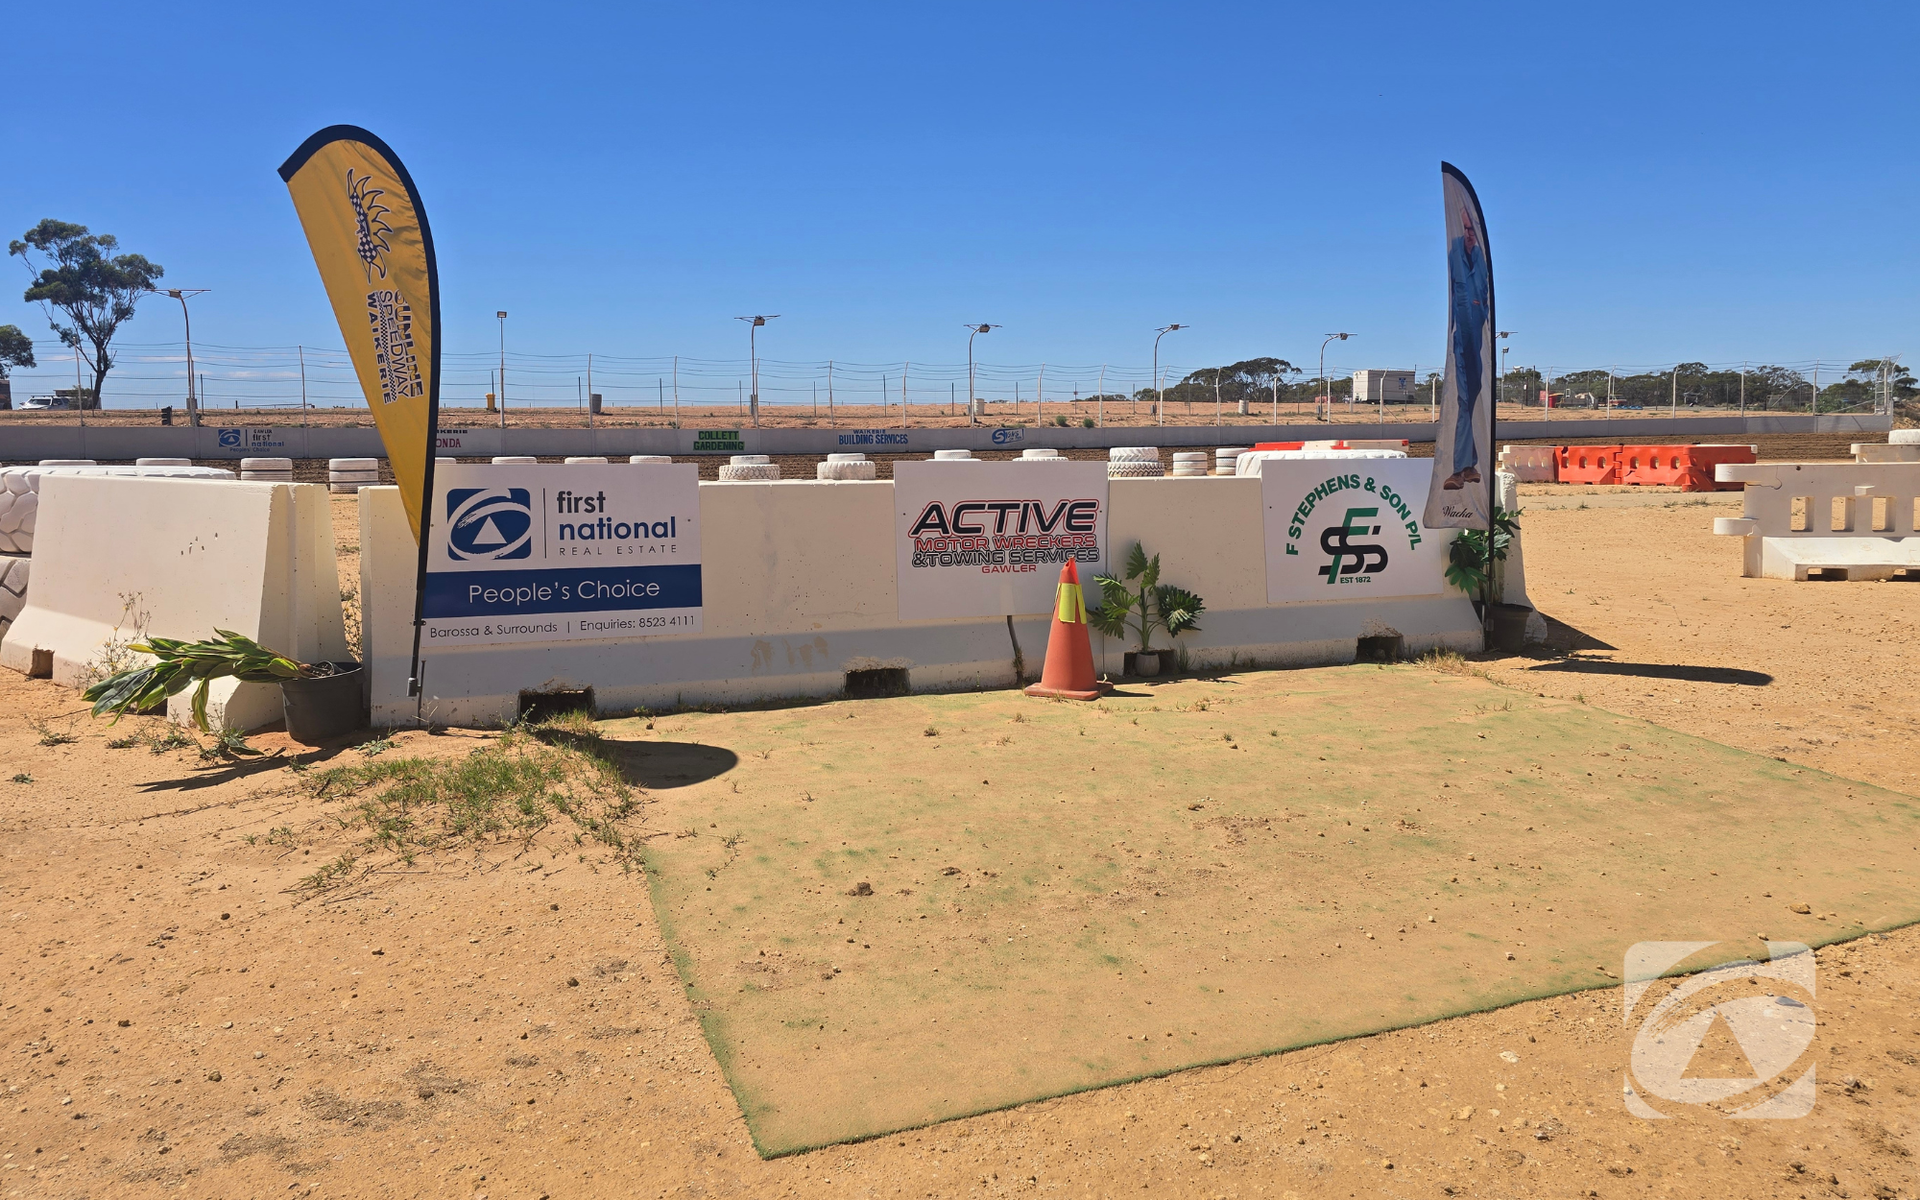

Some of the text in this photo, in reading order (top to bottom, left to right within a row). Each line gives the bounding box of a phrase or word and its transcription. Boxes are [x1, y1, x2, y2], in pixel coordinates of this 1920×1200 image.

[367, 292, 392, 404] WAIKERIE
[380, 290, 410, 397] SPEEDWAY
[394, 289, 424, 398] SUNLINE
[436, 438, 462, 448] ONDA
[693, 441, 744, 450] GARDENING
[698, 430, 739, 440] COLLETT
[838, 434, 908, 445] BUILDING SERVICES
[556, 491, 606, 513] first
[908, 499, 1099, 538] ACTIVE
[1286, 474, 1422, 555] F STEPHENS & SON P/L
[559, 516, 676, 540] national
[560, 545, 677, 556] REAL ESTATE
[915, 535, 1096, 552] MOTOR WRECKERS
[1009, 548, 1100, 565] SERVICES
[981, 565, 1037, 574] GAWLER
[469, 579, 661, 606] People's Choice
[430, 616, 695, 638] Barossa & Surrounds Enquiries: 8523 4111
